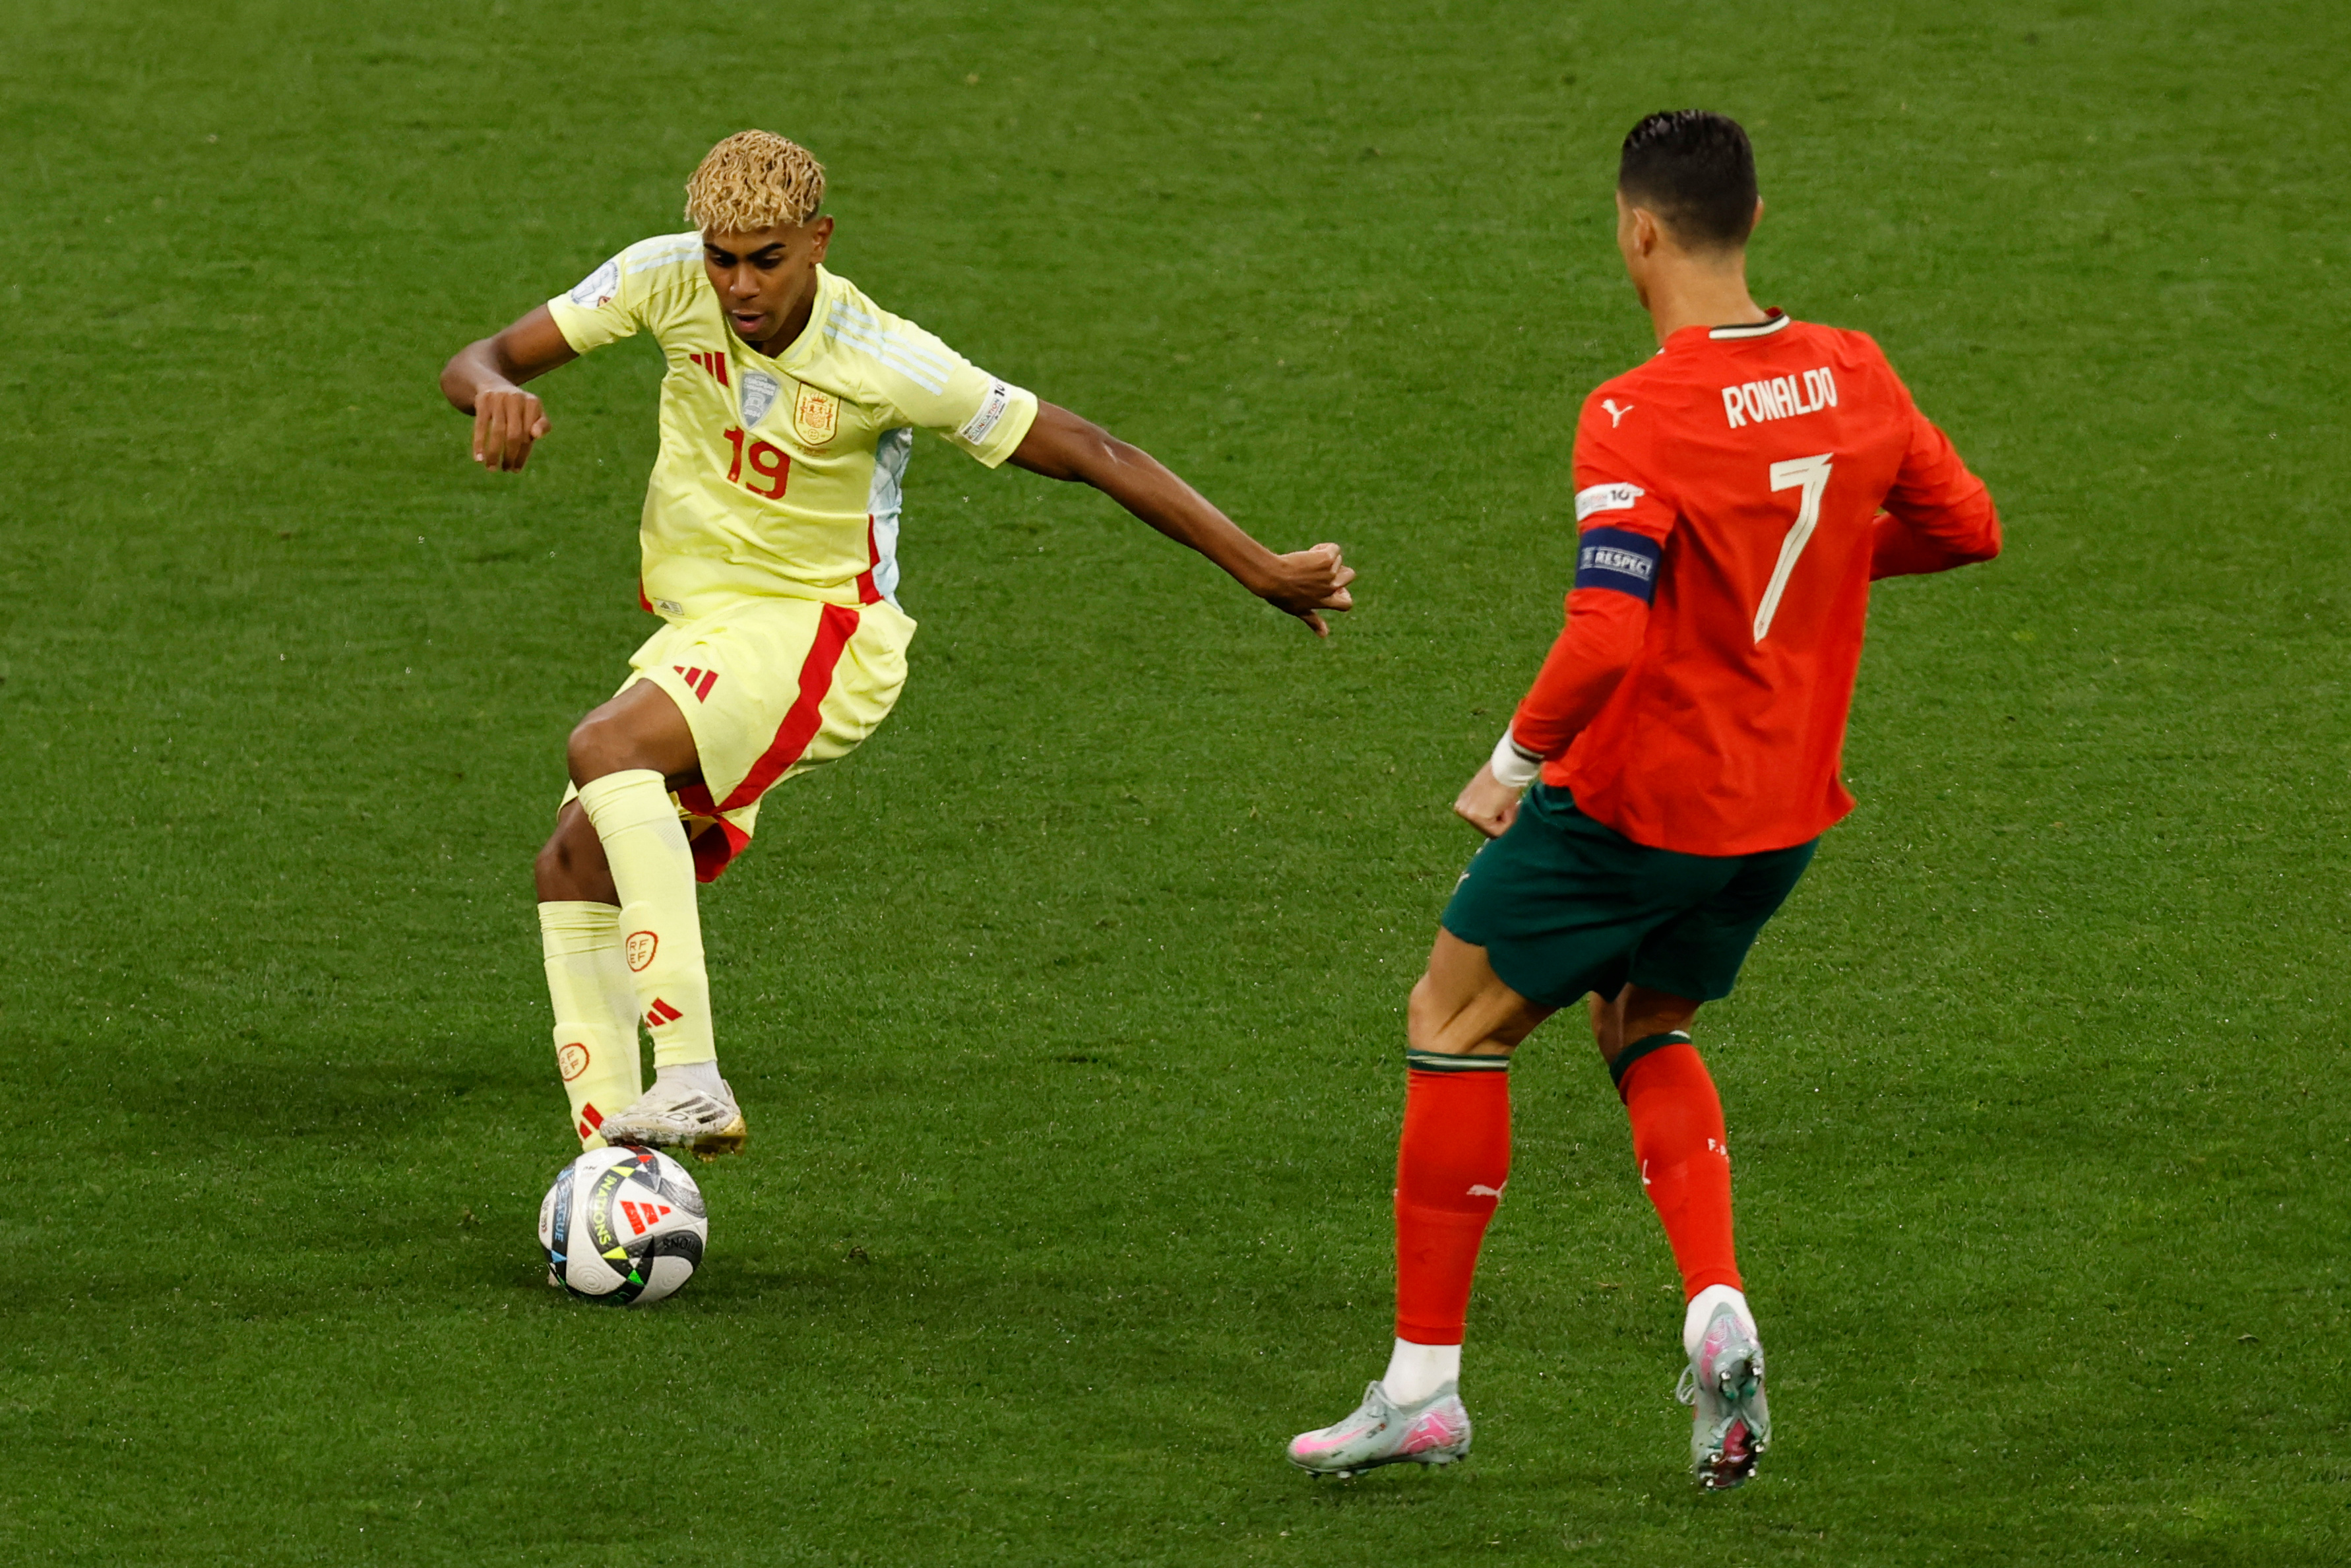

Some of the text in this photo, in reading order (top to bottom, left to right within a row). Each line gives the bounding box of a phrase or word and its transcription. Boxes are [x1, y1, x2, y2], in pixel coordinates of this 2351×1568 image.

[967, 398, 1000, 441] FOUNDATION
[1722, 367, 1837, 428] RONALDO
[724, 426, 791, 500] 19
[1753, 453, 1833, 644] 7
